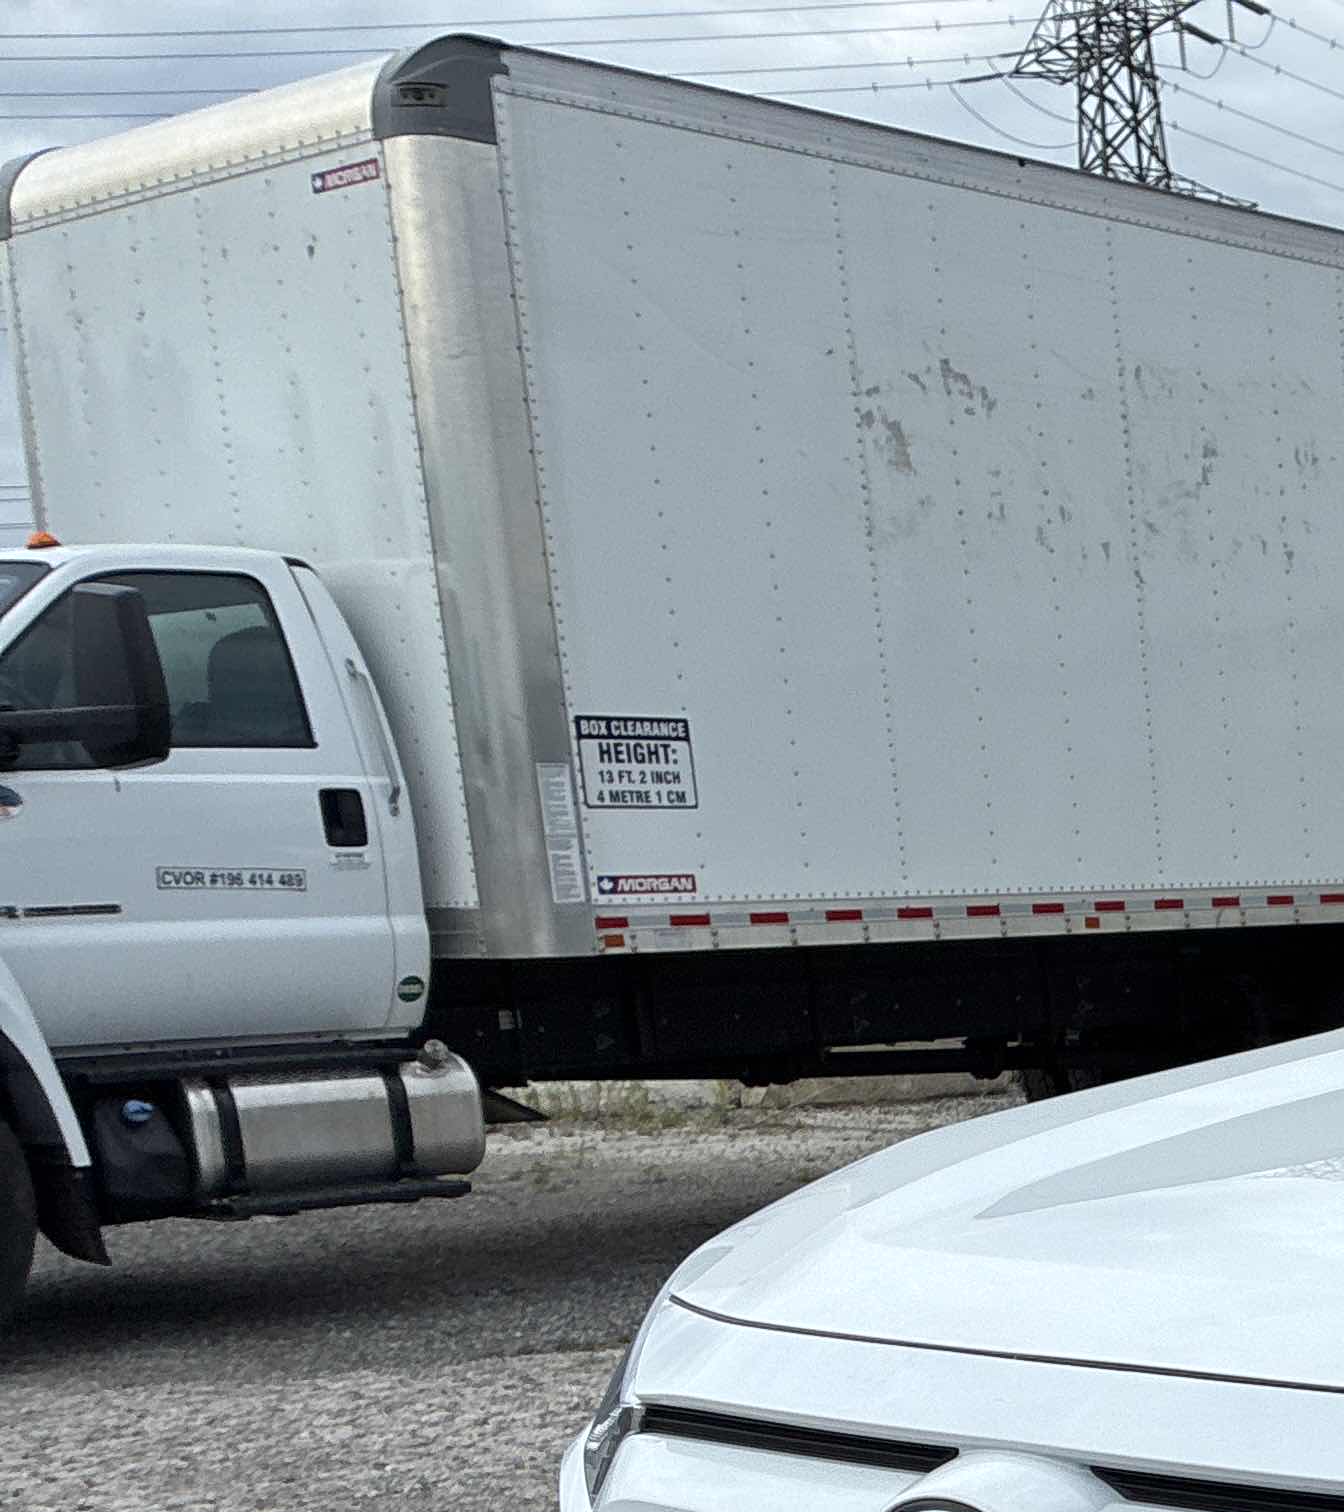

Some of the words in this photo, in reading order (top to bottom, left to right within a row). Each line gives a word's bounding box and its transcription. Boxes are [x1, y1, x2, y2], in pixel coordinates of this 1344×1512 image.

[580, 719, 608, 736] BOX
[610, 720, 687, 737] CLEARANCE
[598, 742, 679, 765] HEIGHT:
[598, 770, 614, 784] 13
[618, 770, 636, 784] FT.
[639, 770, 648, 784] 2
[650, 771, 682, 784] INCH
[597, 790, 605, 803] 4
[608, 790, 652, 804] METRE
[666, 790, 687, 804] CM
[161, 870, 206, 886] CVOR
[617, 876, 694, 892] MORGAN
